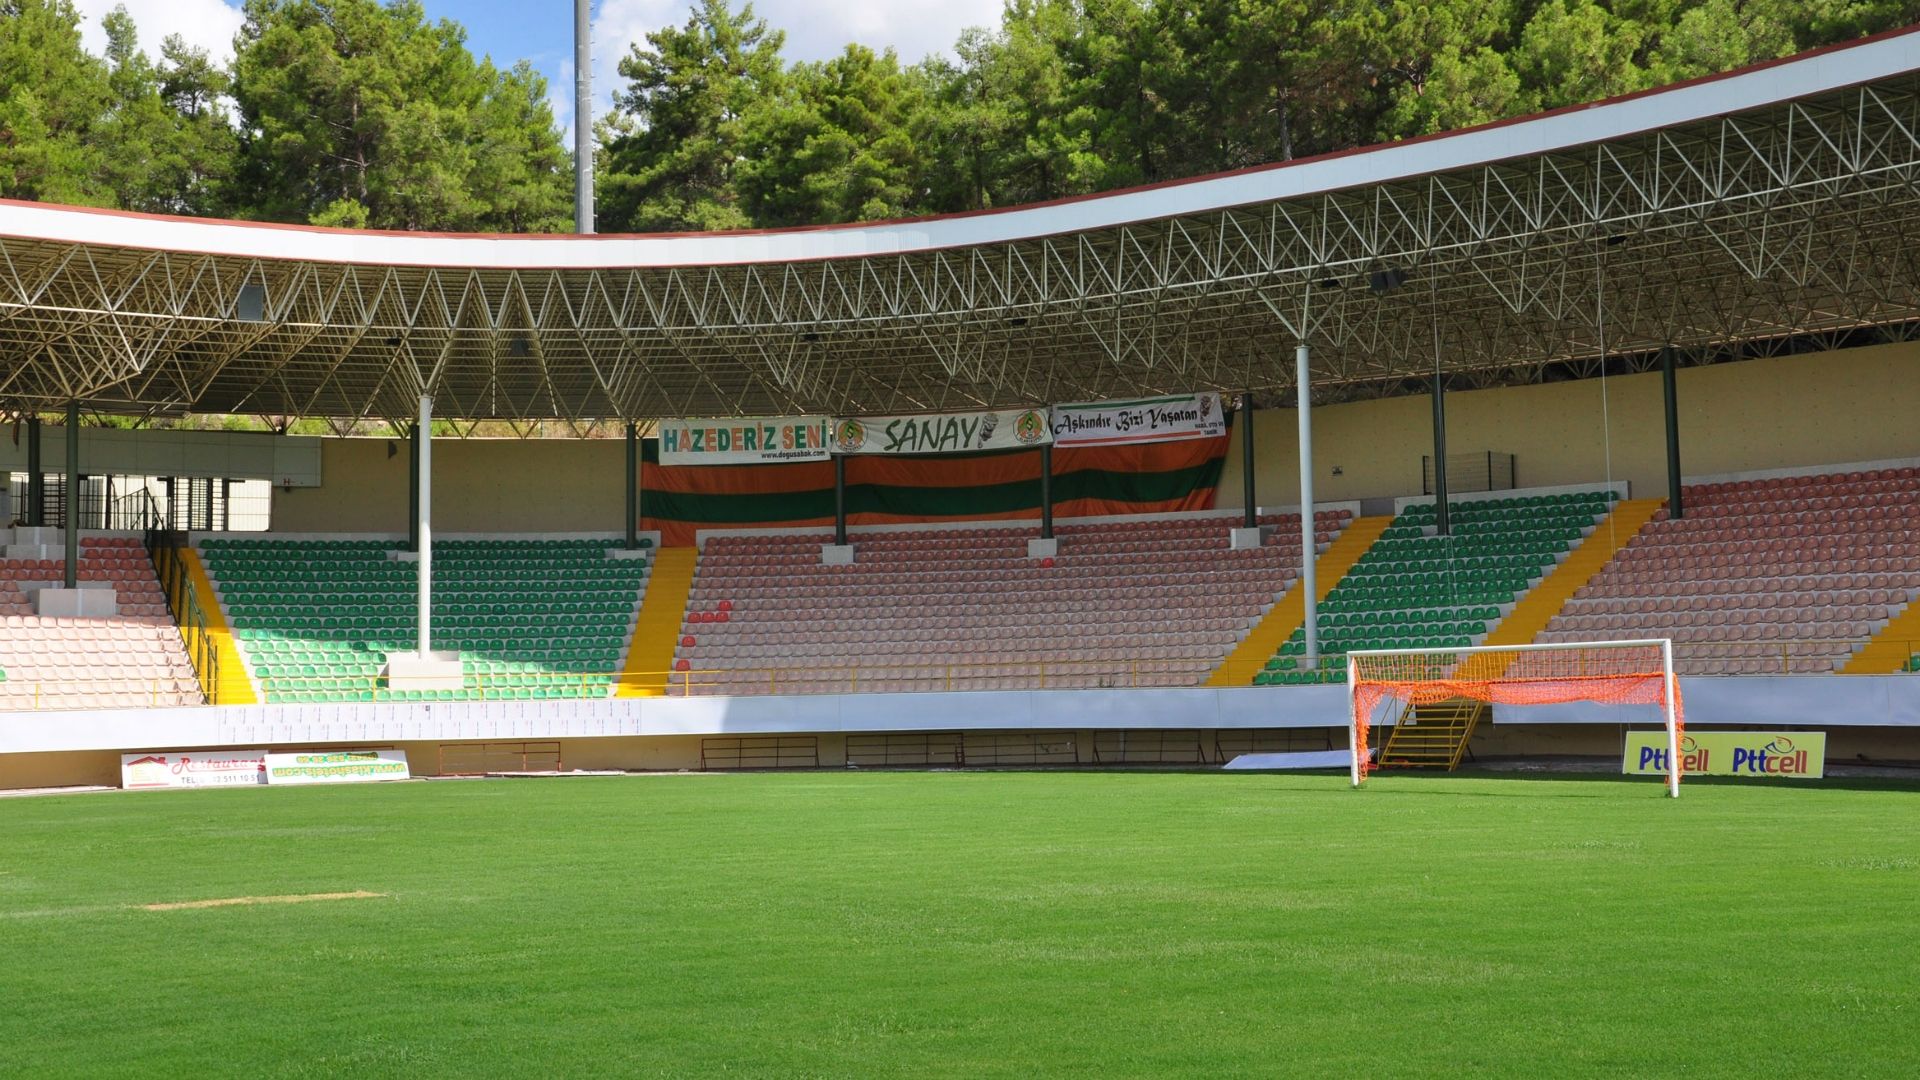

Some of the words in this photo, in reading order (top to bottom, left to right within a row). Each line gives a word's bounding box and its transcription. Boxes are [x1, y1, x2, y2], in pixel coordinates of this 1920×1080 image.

[883, 416, 979, 452] SANAY
[1055, 410, 1112, 434] Aşkındır
[1115, 409, 1144, 431] Bizi
[1149, 407, 1198, 429] Yaşatan
[663, 421, 777, 453] HAZEDERİZ
[782, 419, 827, 449] SENİ
[1732, 747, 1808, 774] Pttcell
